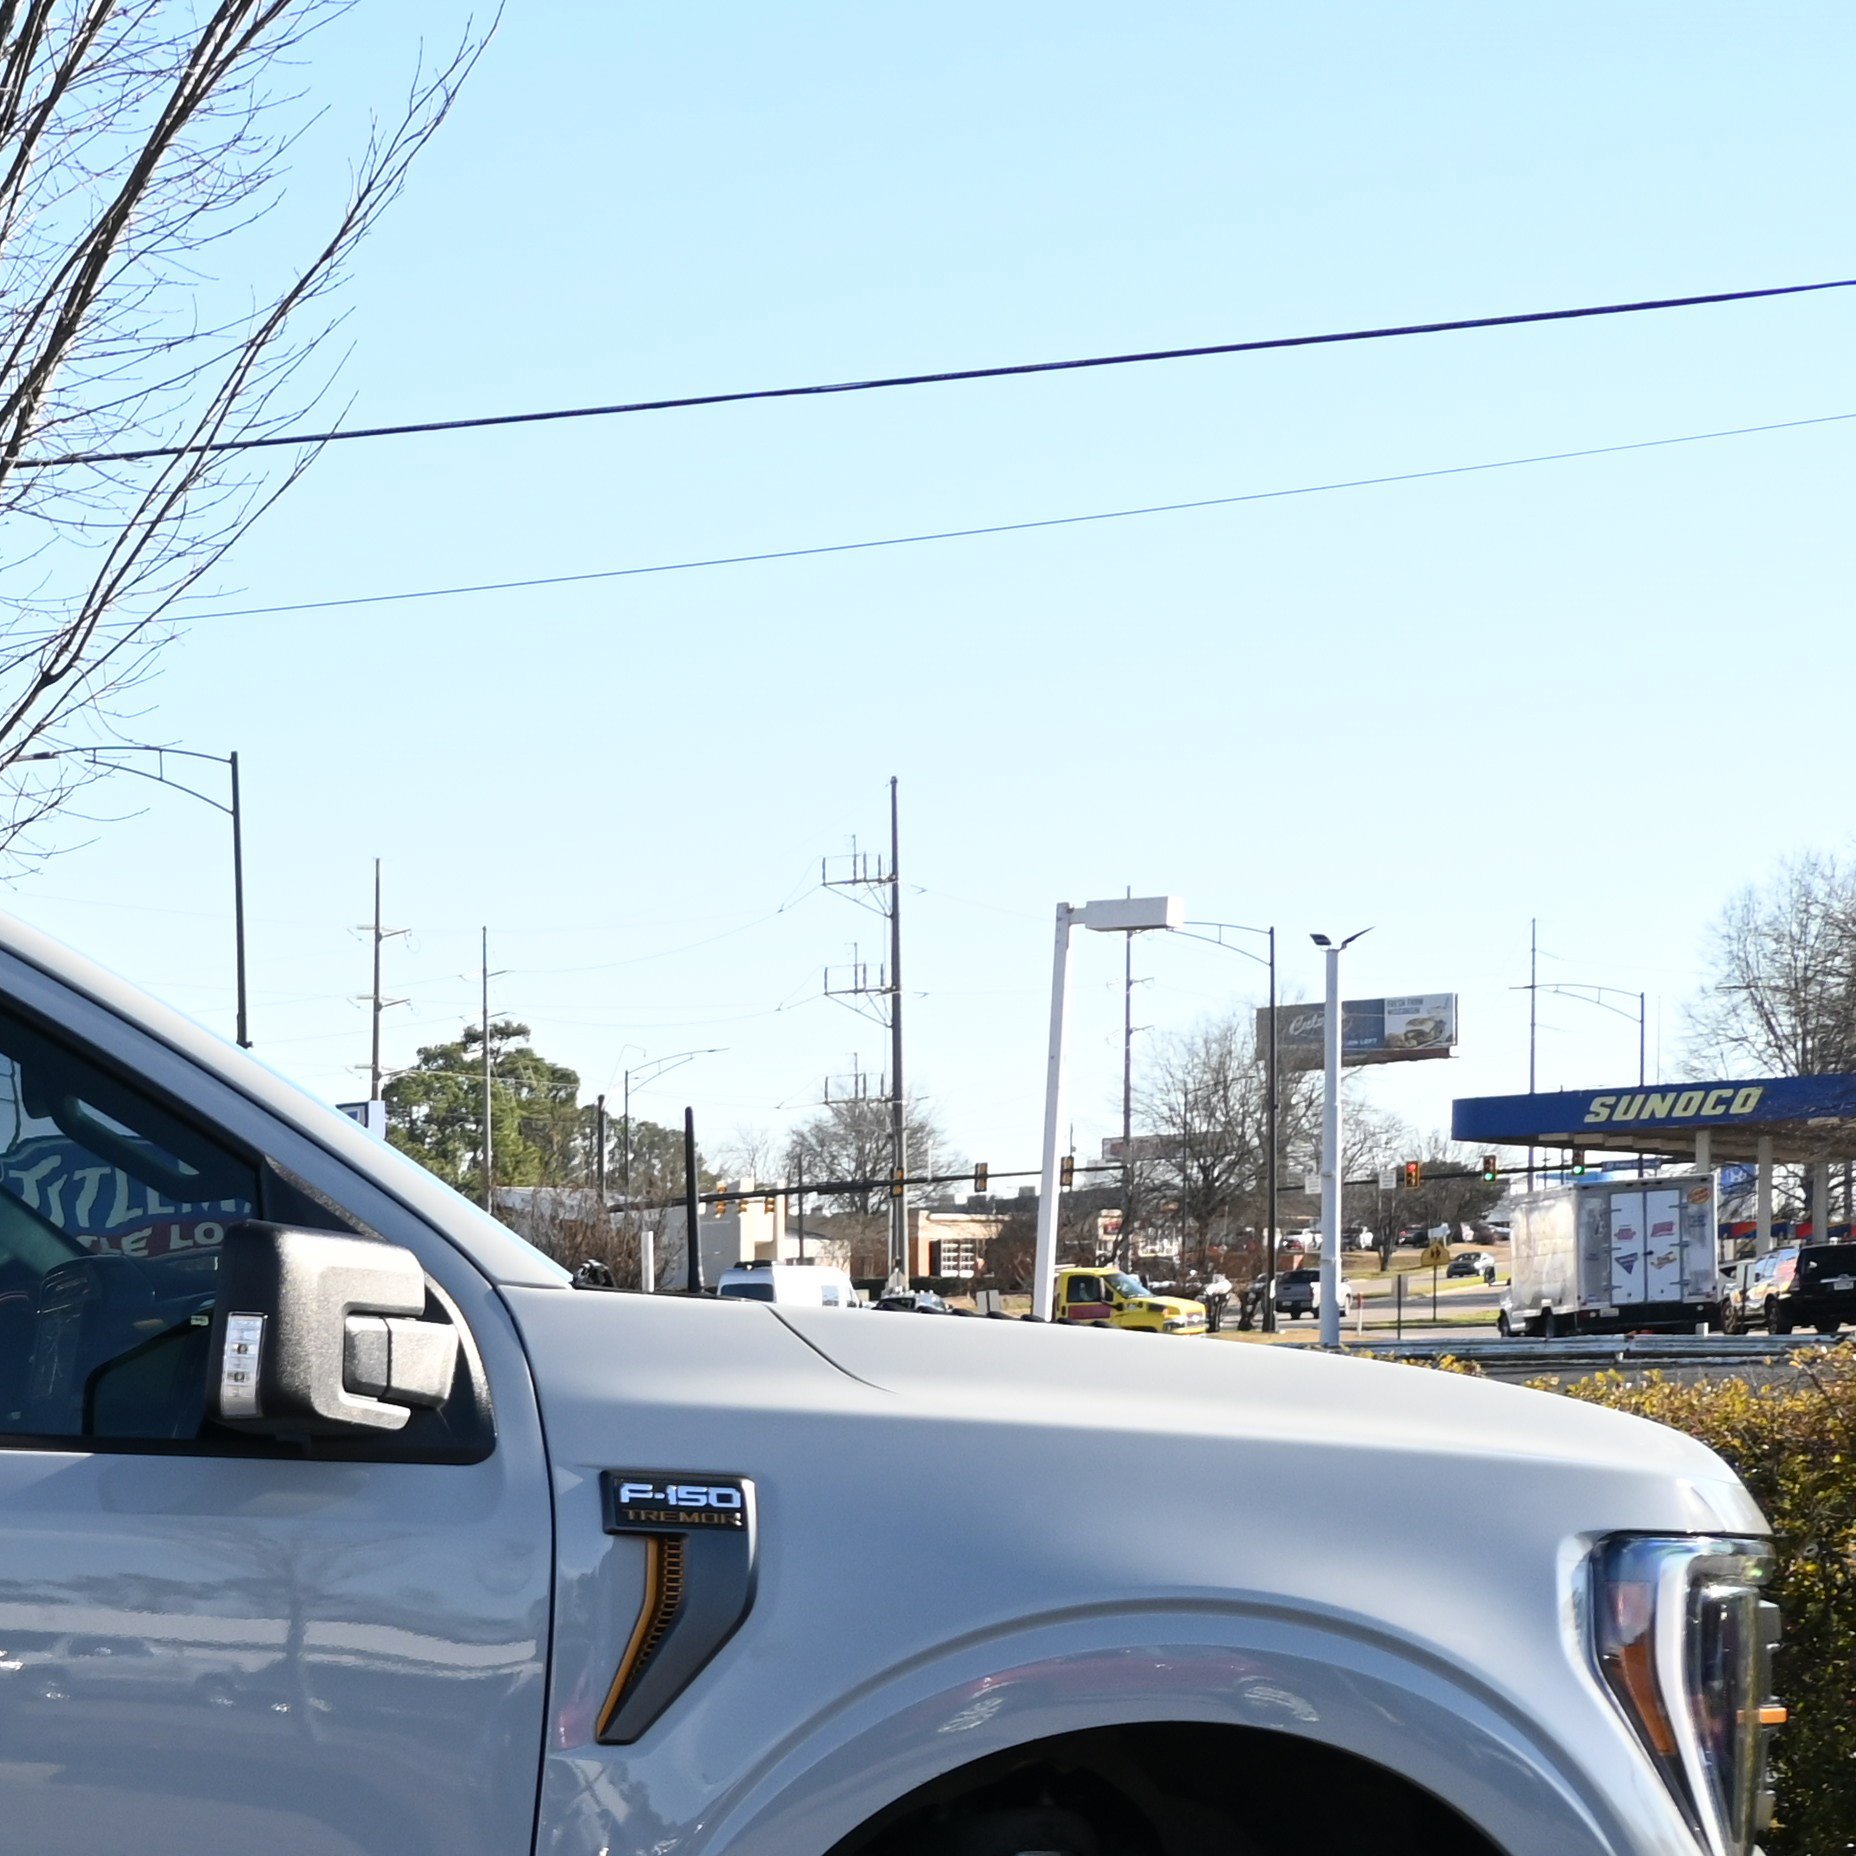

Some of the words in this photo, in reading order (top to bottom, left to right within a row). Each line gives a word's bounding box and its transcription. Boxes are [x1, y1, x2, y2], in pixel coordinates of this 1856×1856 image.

[1584, 1086, 1764, 1123] SUNOCO
[619, 1482, 742, 1508] F-150
[624, 1509, 743, 1526] TREMOR
